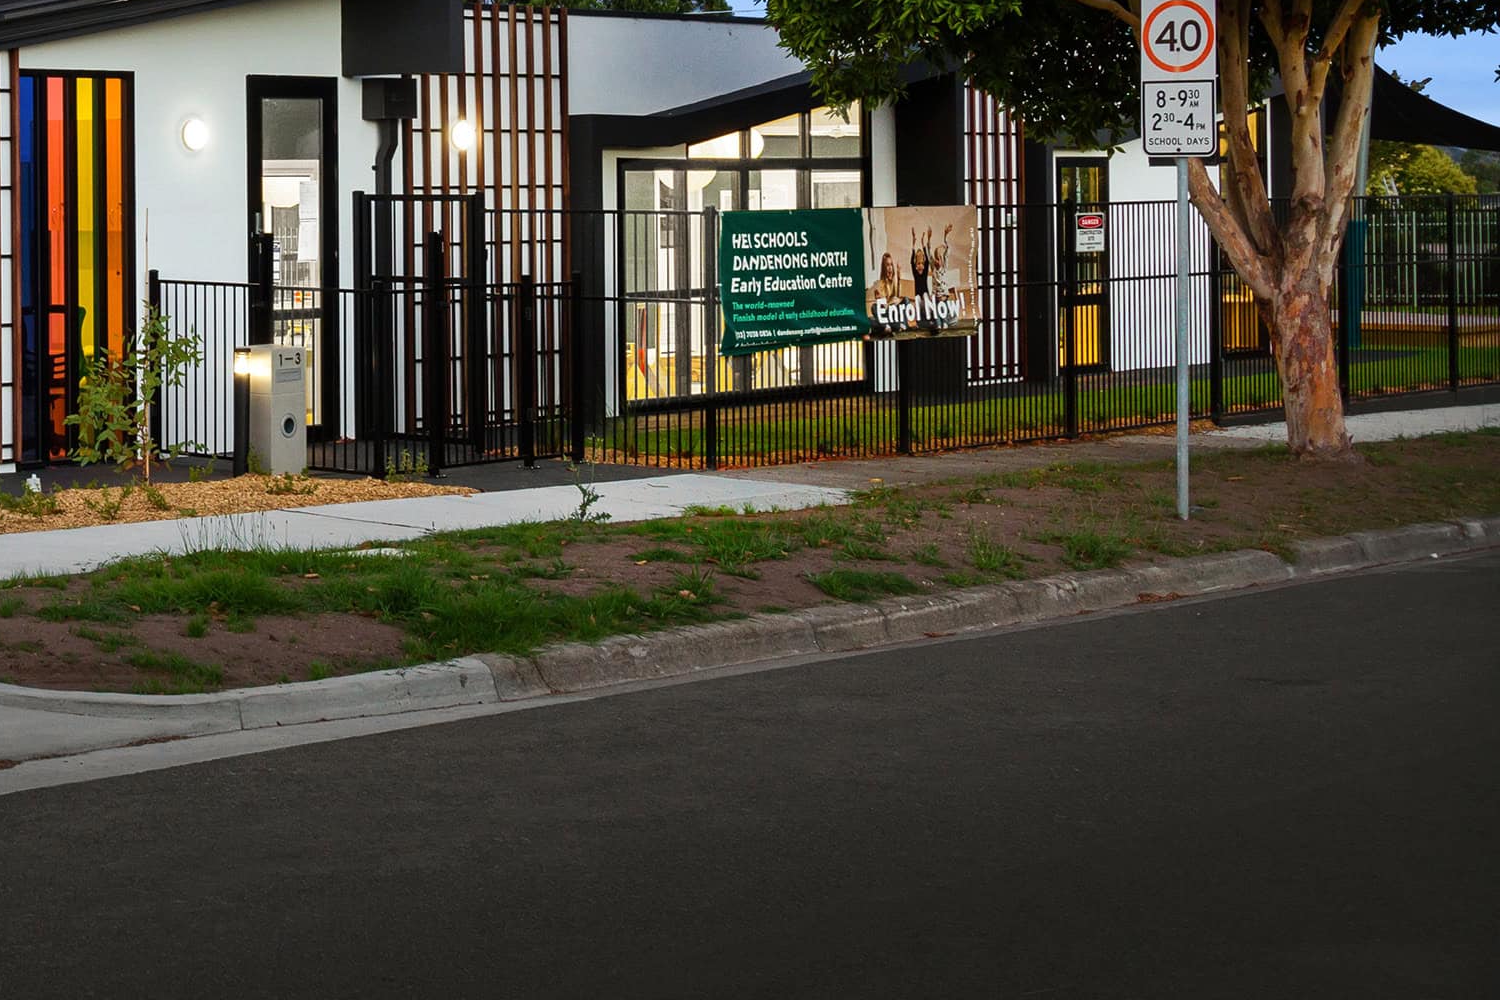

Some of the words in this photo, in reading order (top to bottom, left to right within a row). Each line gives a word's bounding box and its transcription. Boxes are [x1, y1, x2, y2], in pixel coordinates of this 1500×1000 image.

[1155, 20, 1202, 52] 40
[1148, 137, 1183, 146] SCHOOL
[1186, 137, 1210, 146] DAYS
[753, 231, 808, 249] SCHOOLS
[733, 253, 809, 271] DANDENONG
[810, 251, 848, 268] NORTH
[731, 277, 761, 296] Early
[764, 274, 817, 292] Education
[818, 273, 853, 289] Centre
[756, 312, 778, 321] model
[799, 308, 828, 319] childhood
[876, 295, 921, 325] Enrol
[924, 292, 966, 320] Now!
